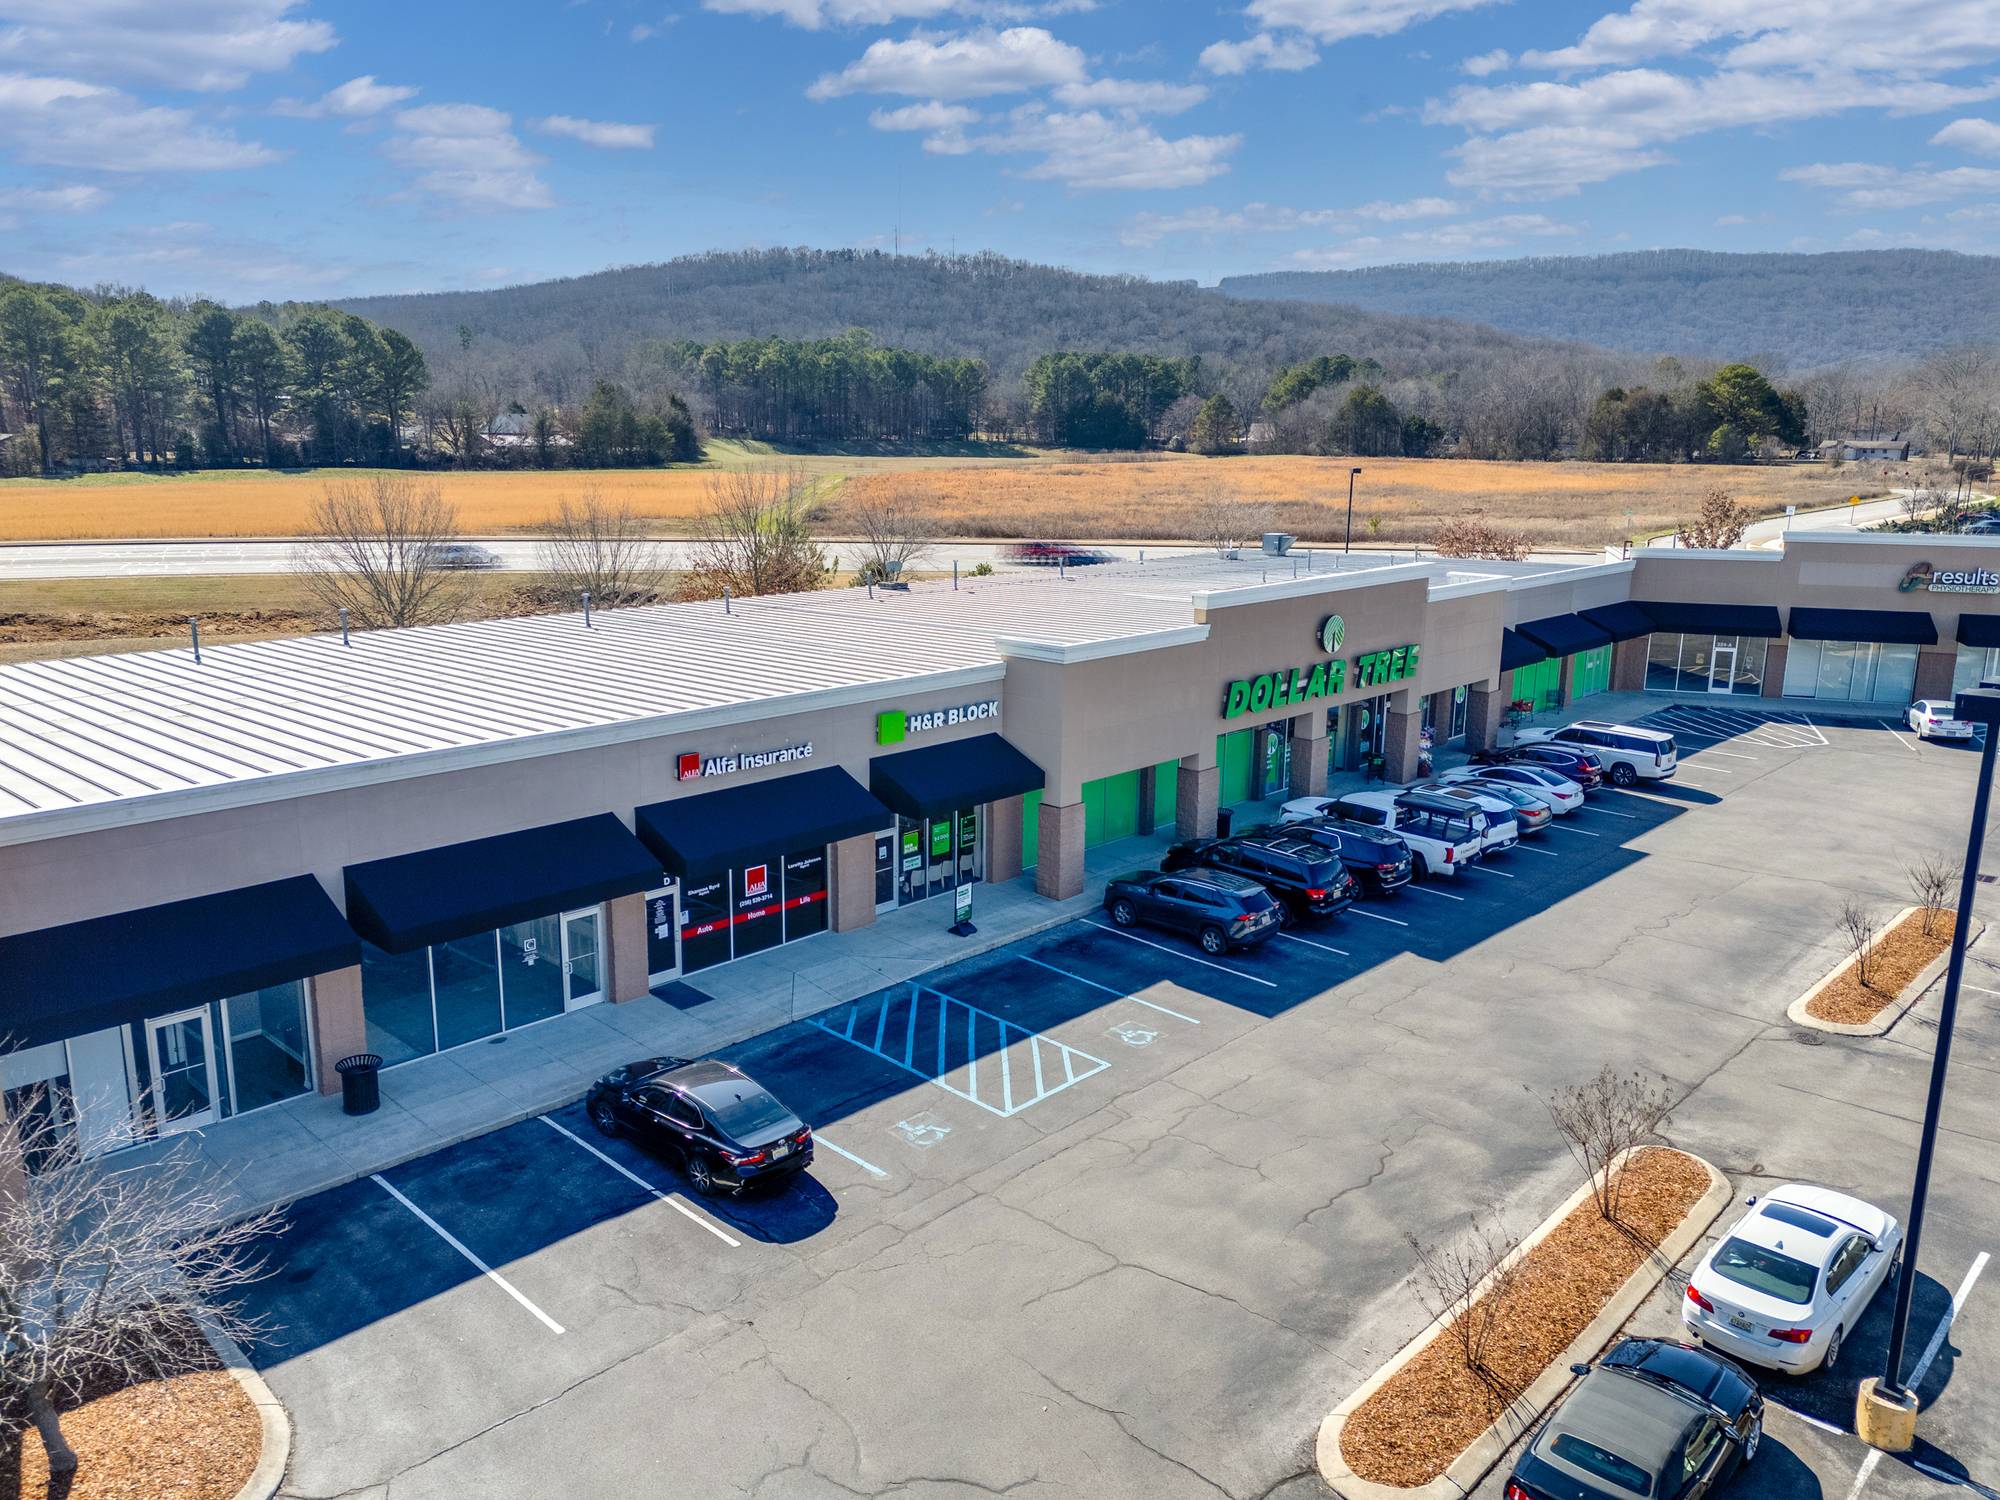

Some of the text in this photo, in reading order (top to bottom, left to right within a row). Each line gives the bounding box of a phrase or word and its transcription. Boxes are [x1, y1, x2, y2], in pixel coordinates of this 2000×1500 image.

[1933, 567, 1999, 586] results
[1931, 584, 1997, 592] PHYSIOTHERAPY
[1224, 644, 1421, 720] DOLLAR TREE
[910, 701, 999, 733] H&R BLOCK
[704, 745, 813, 777] Alfa Insurance
[799, 895, 811, 905] Life
[747, 909, 766, 920] Home
[696, 924, 713, 935] Auto
